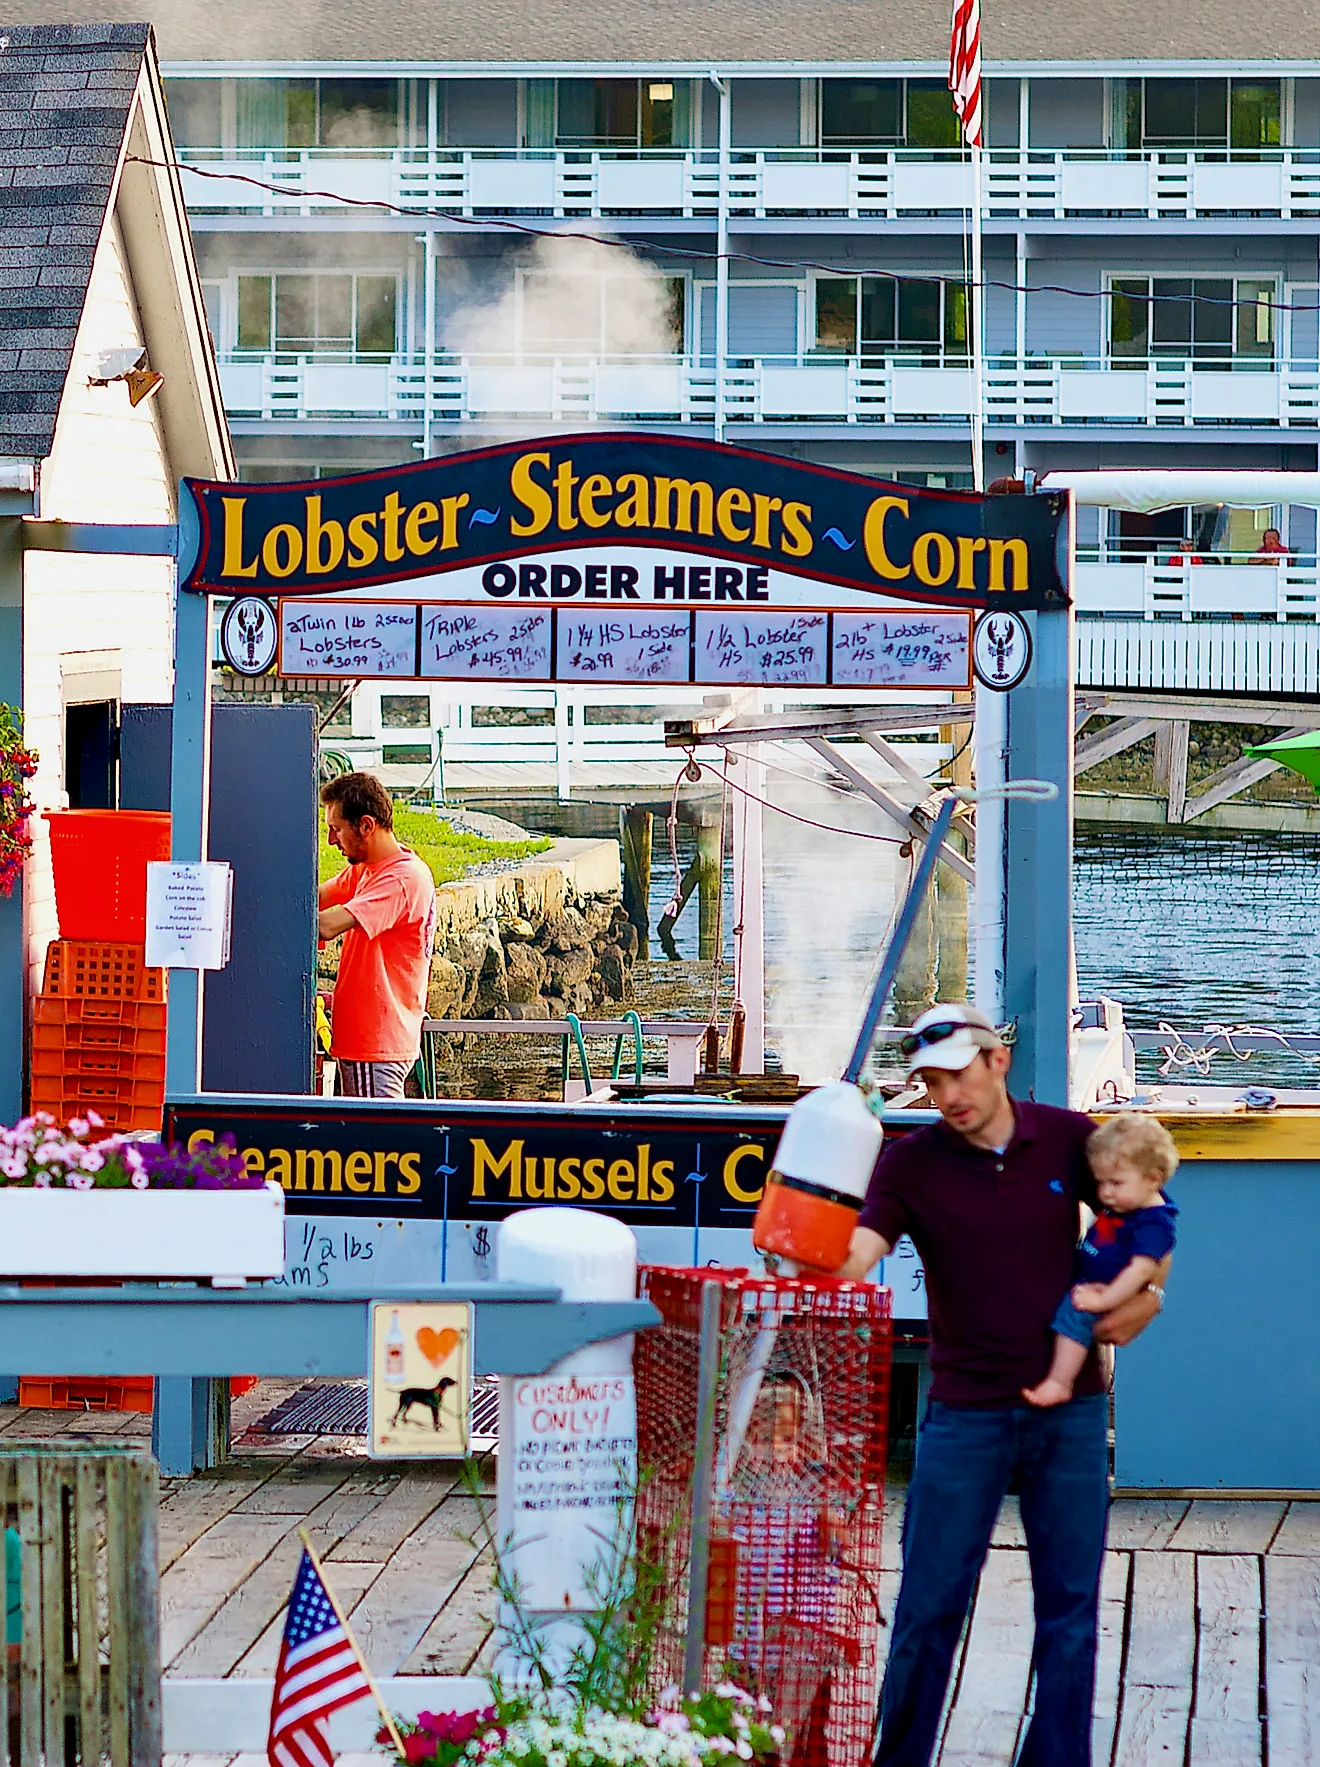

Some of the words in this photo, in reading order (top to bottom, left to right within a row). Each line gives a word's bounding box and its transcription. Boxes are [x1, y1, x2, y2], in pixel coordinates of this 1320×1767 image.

[220, 490, 470, 578] Lobster
[510, 451, 814, 557] Steamers
[863, 495, 1029, 592] Corn
[481, 563, 640, 599] ORDER
[653, 565, 770, 600] HERE
[468, 1137, 675, 1202] Mussels
